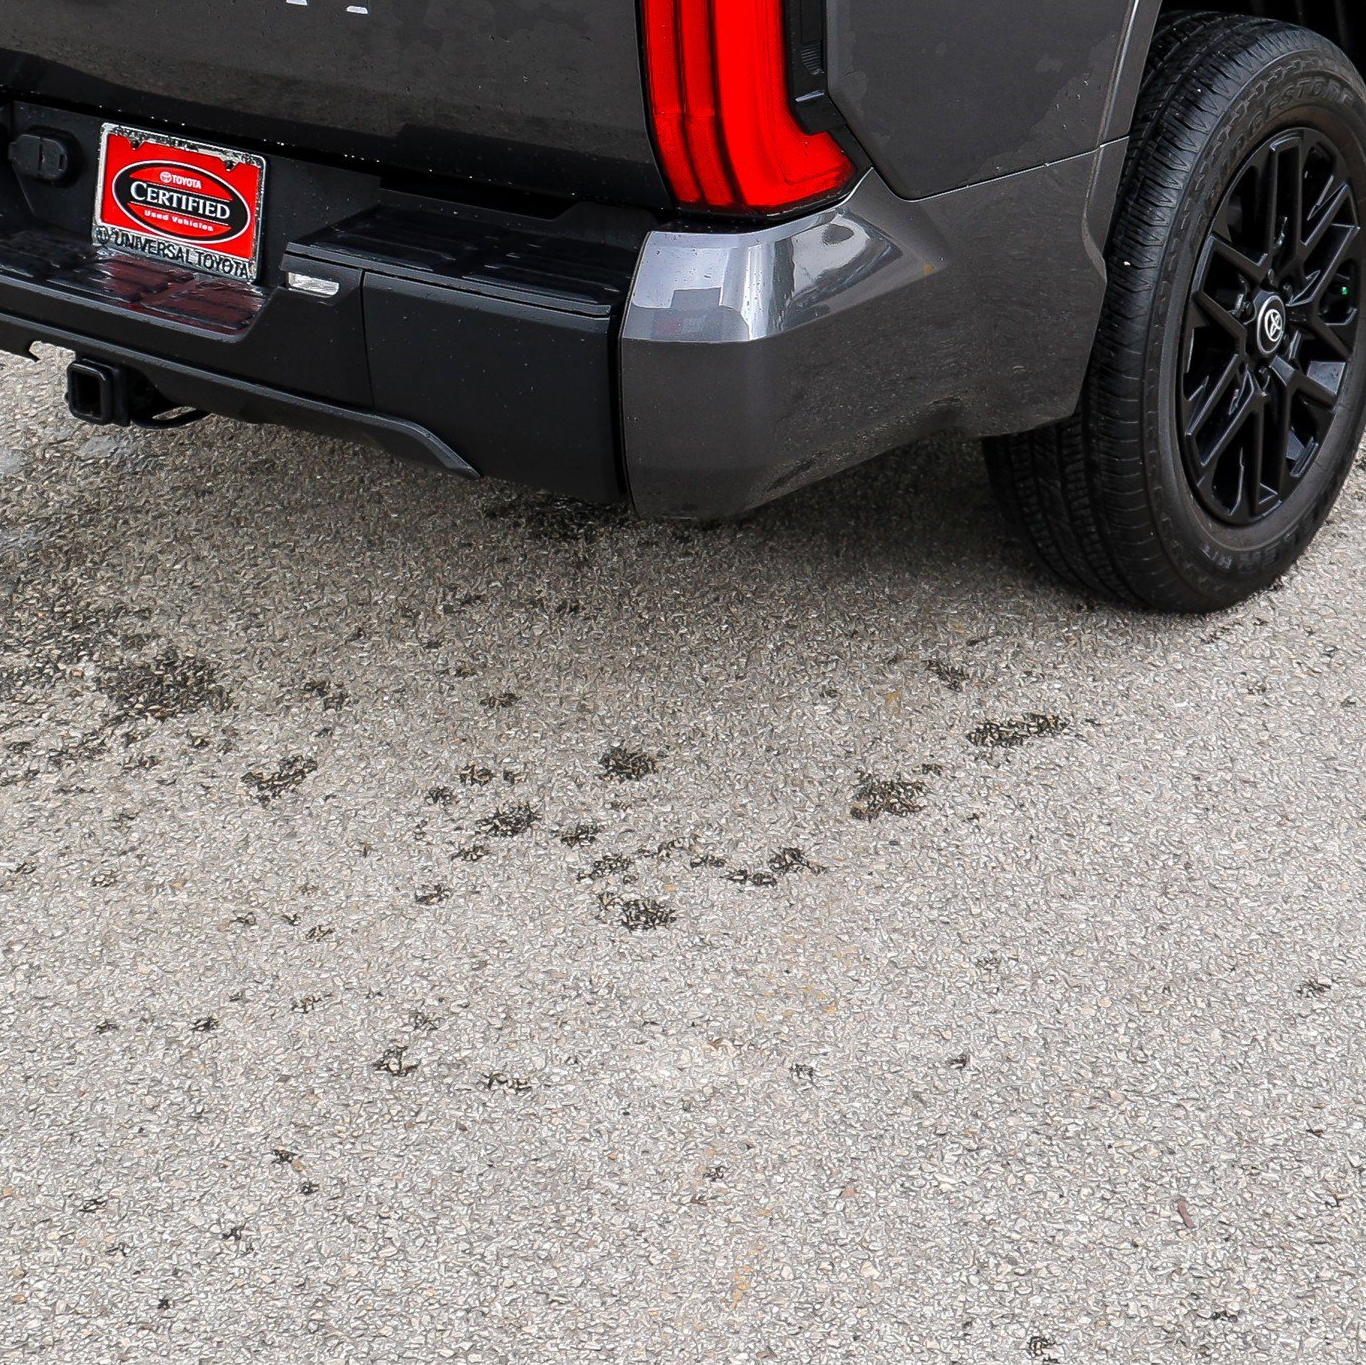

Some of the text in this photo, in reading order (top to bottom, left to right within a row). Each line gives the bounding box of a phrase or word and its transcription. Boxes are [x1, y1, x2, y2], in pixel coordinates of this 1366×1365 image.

[172, 174, 202, 190] TOYOTA
[130, 181, 230, 220] CERTIFIED
[144, 210, 214, 232] Used Vehicles
[115, 230, 251, 279] UNIVERSAL TOYOTA
